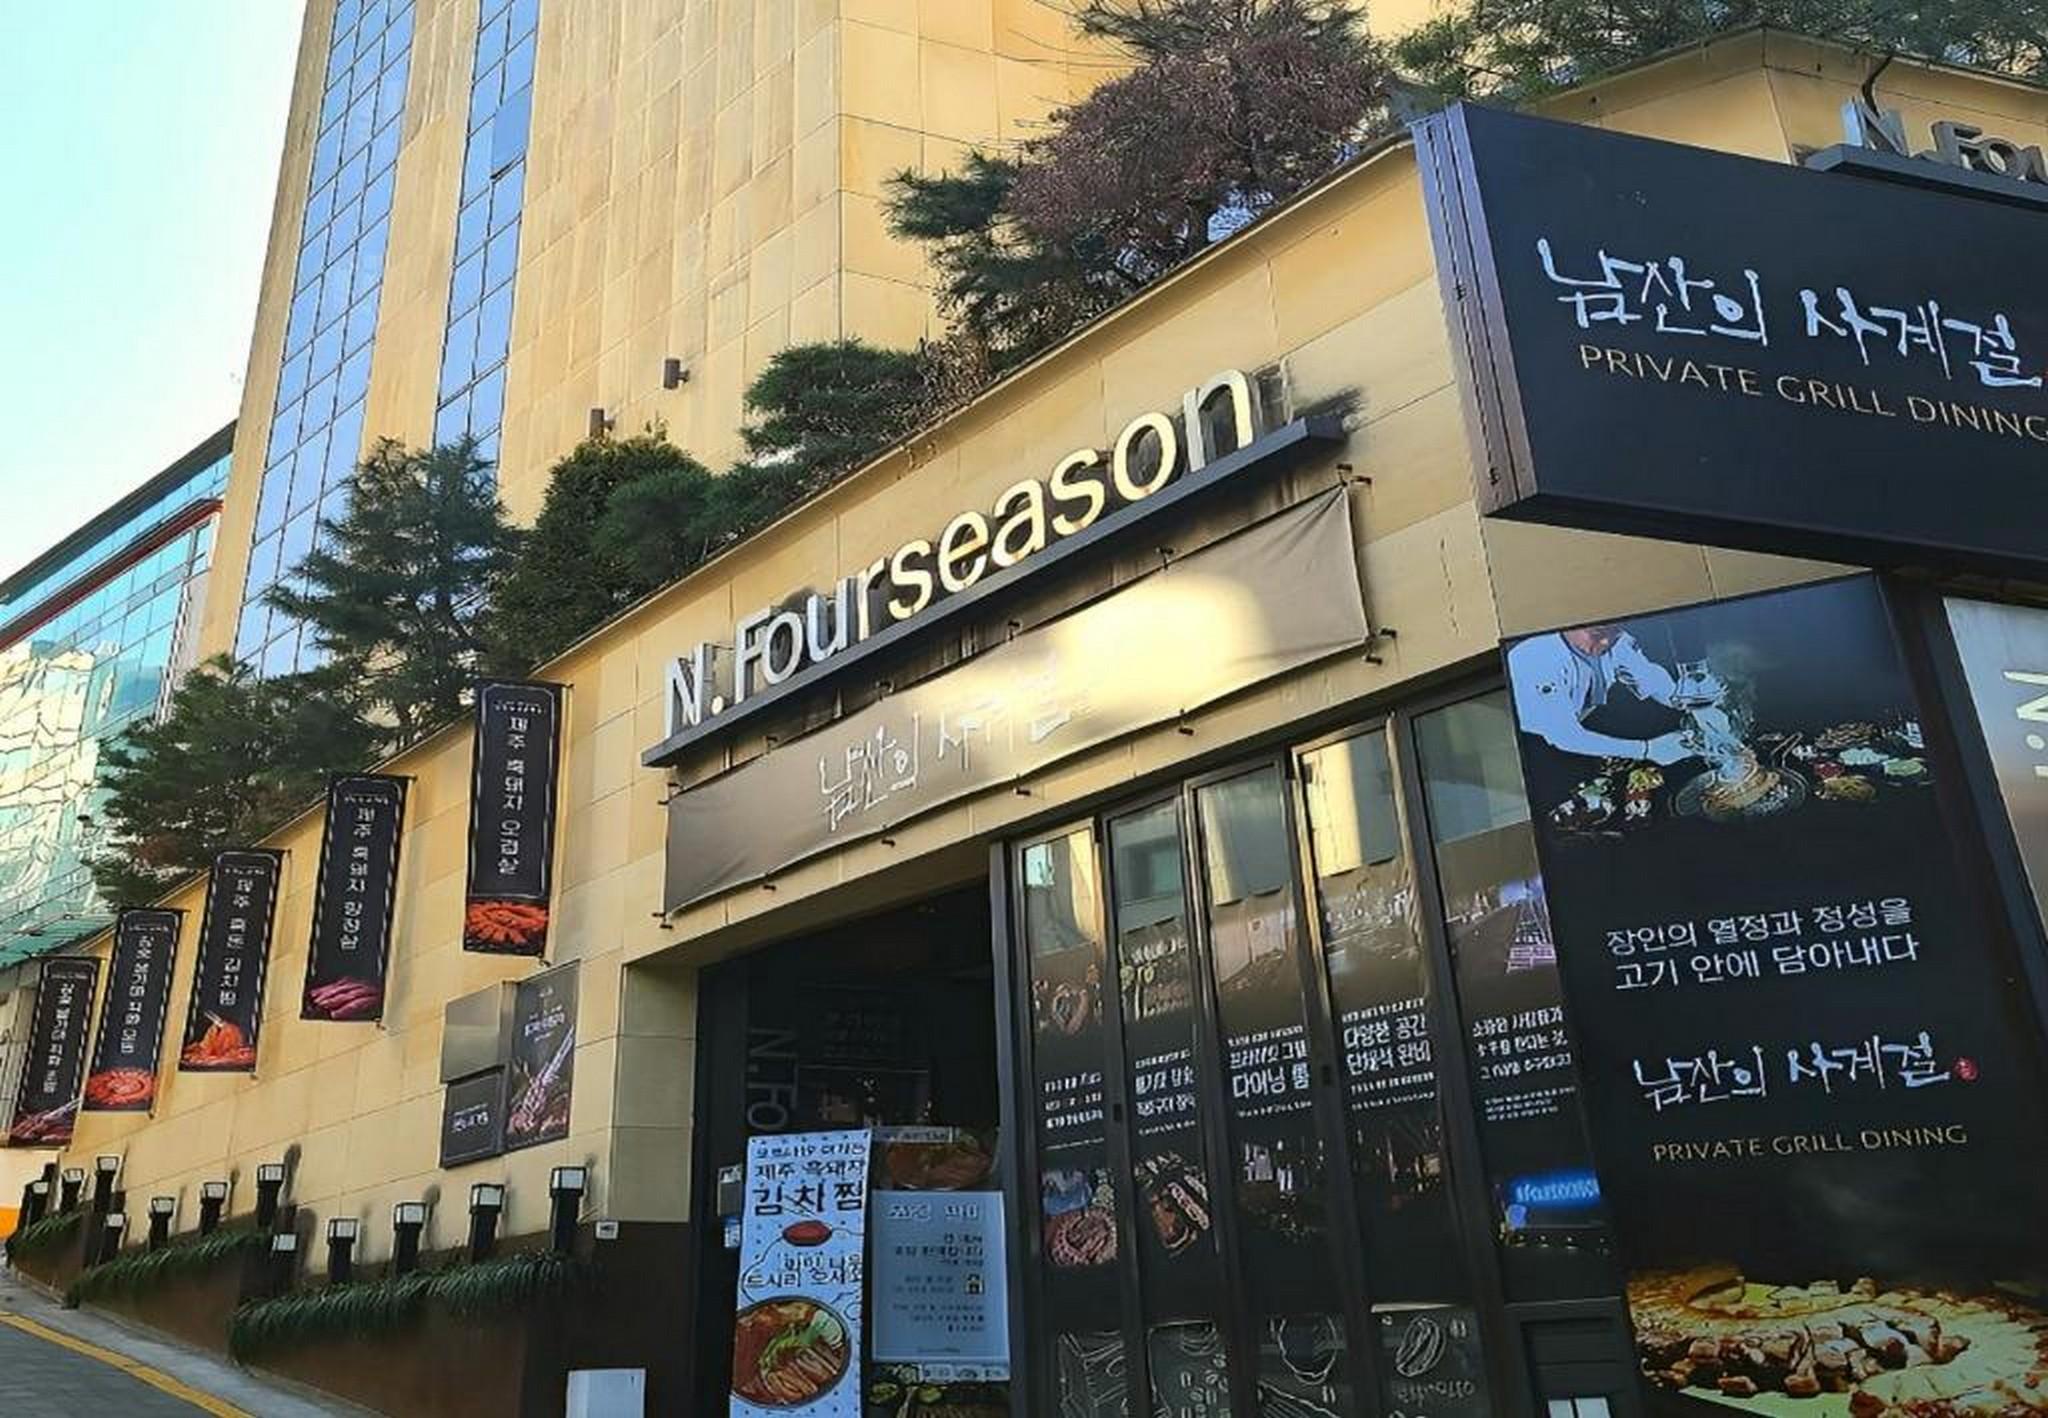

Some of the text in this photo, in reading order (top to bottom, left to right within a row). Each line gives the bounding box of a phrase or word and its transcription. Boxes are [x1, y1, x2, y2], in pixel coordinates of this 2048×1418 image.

[1537, 238, 2042, 387] 남산의 사계절
[1579, 343, 1763, 398] PRIVATE
[1775, 375, 1897, 418] GRILL
[1606, 897, 1912, 956] 장인의 열정과 정성을
[1616, 932, 1920, 990] 고기 안에 담아내다
[1633, 1044, 1768, 1112] 남산의
[1787, 1031, 1951, 1094] 사계절
[755, 1161, 796, 1181] 제주
[1652, 1124, 1968, 1163] PRIVATE GRILL DINING
[752, 1180, 864, 1217] 김치찜
